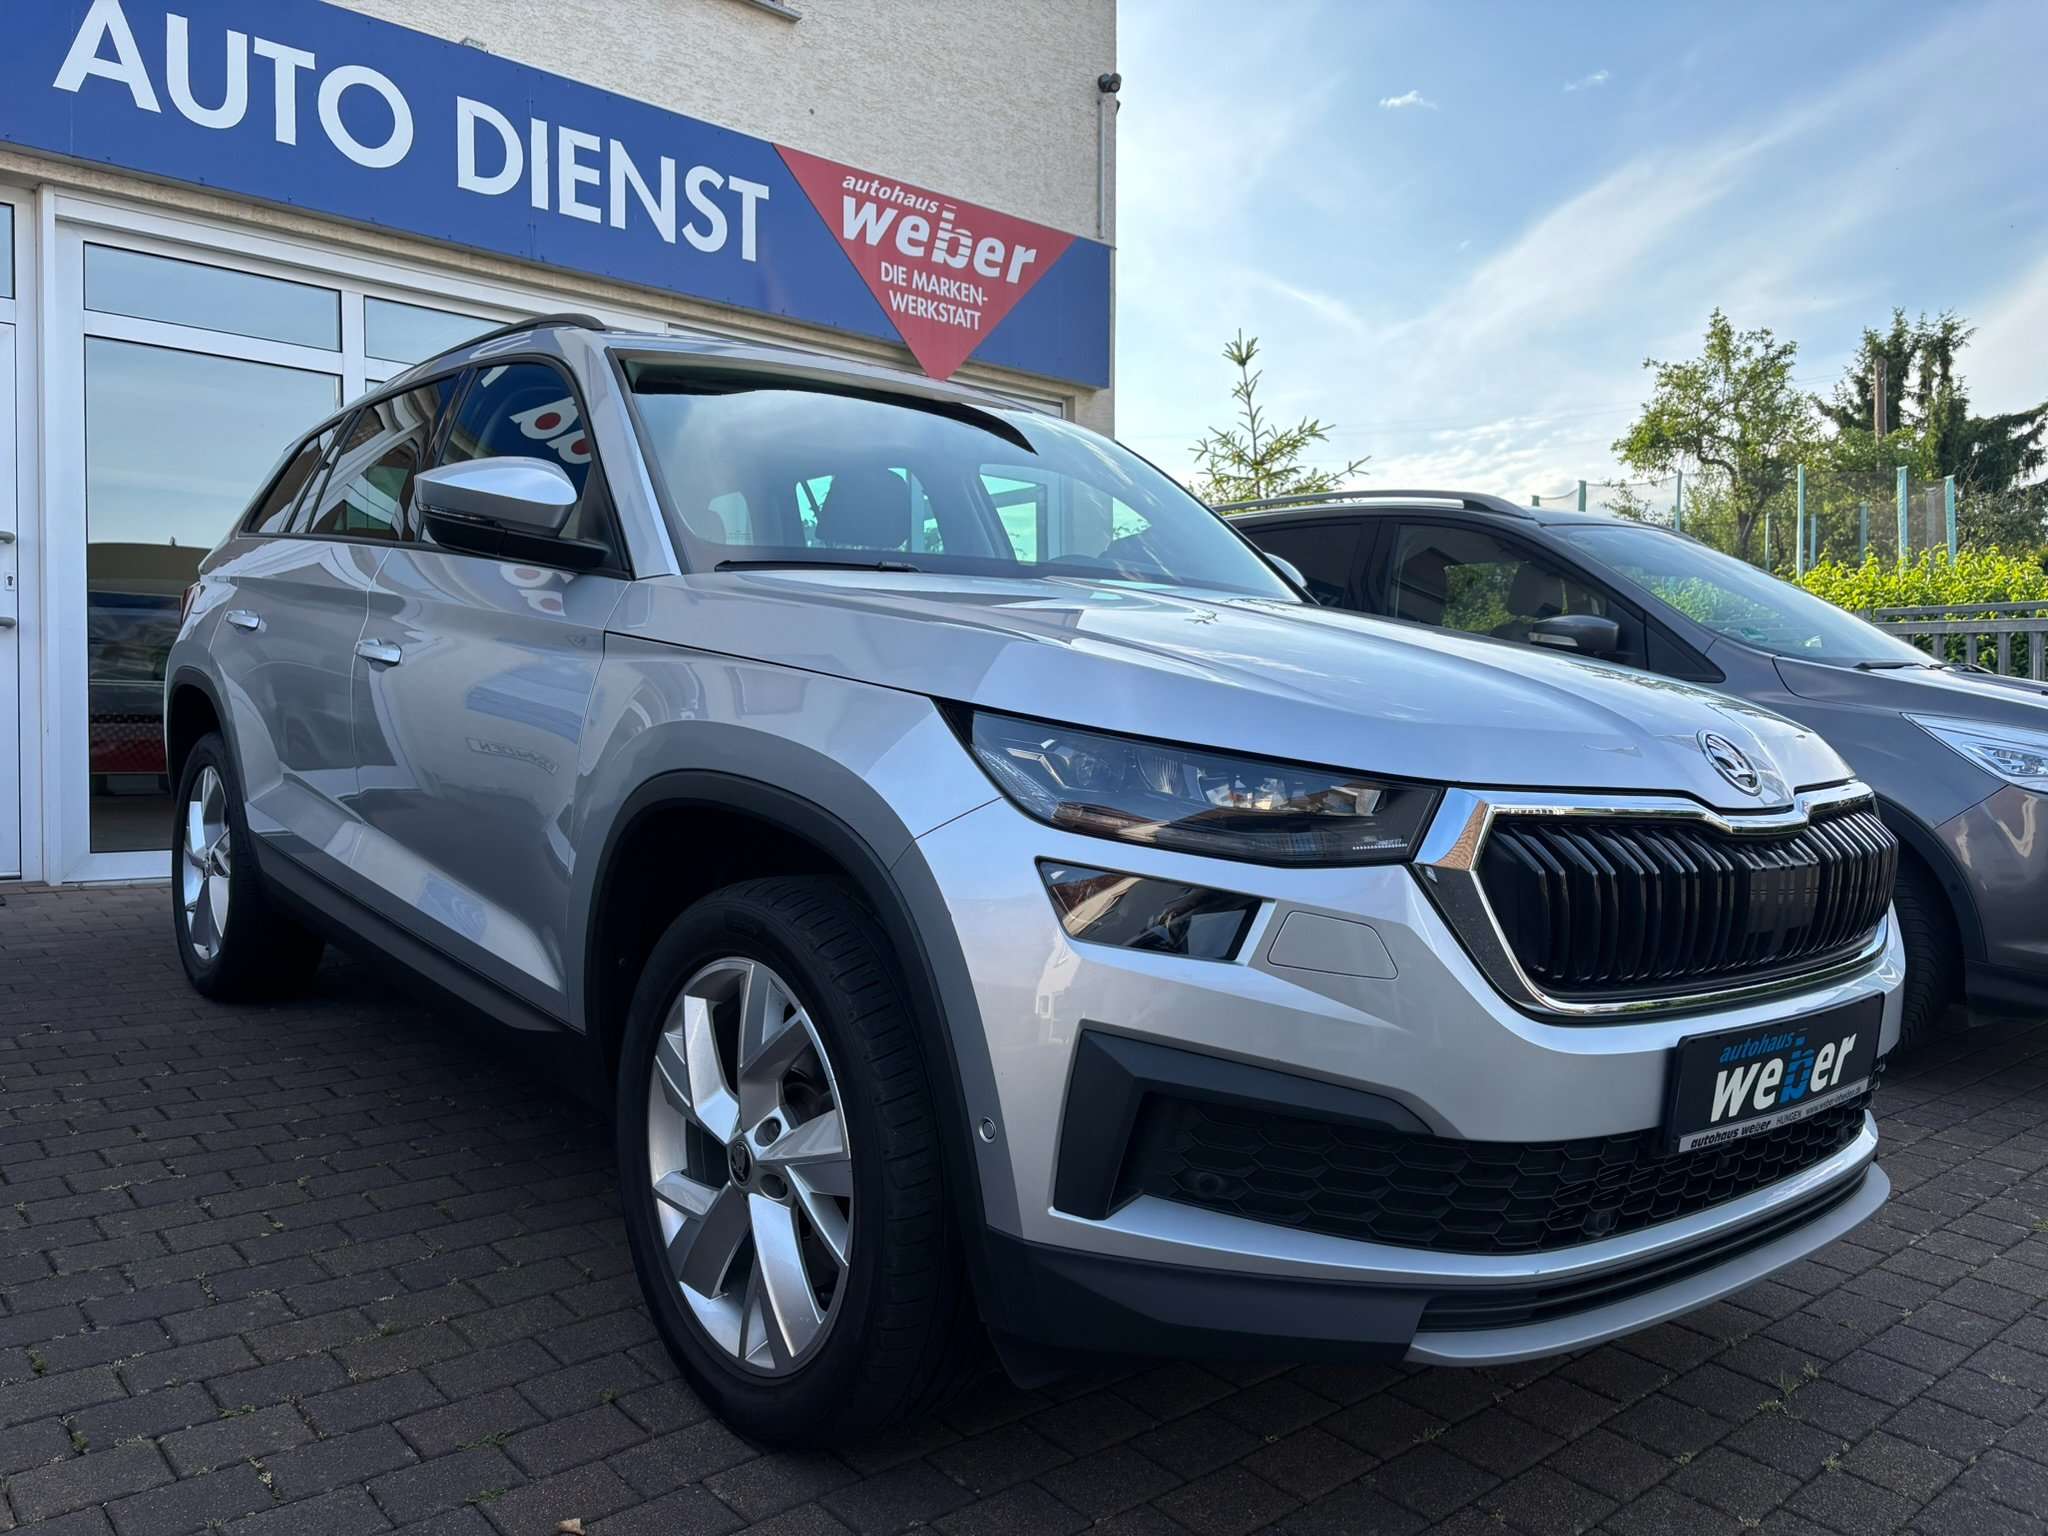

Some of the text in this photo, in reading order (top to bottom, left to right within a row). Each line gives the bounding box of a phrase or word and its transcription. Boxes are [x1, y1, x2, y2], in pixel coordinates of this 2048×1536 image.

[53, 0, 769, 262] AUTO DIENST
[842, 175, 939, 214] autohaus
[842, 195, 1037, 284] weber
[880, 261, 988, 305] DIE MARKEN-
[888, 290, 981, 331] WERKSTATT
[1719, 1031, 1794, 1063] autohaus
[1710, 1033, 1858, 1123] weber
[1690, 1128, 1740, 1149] autohaus
